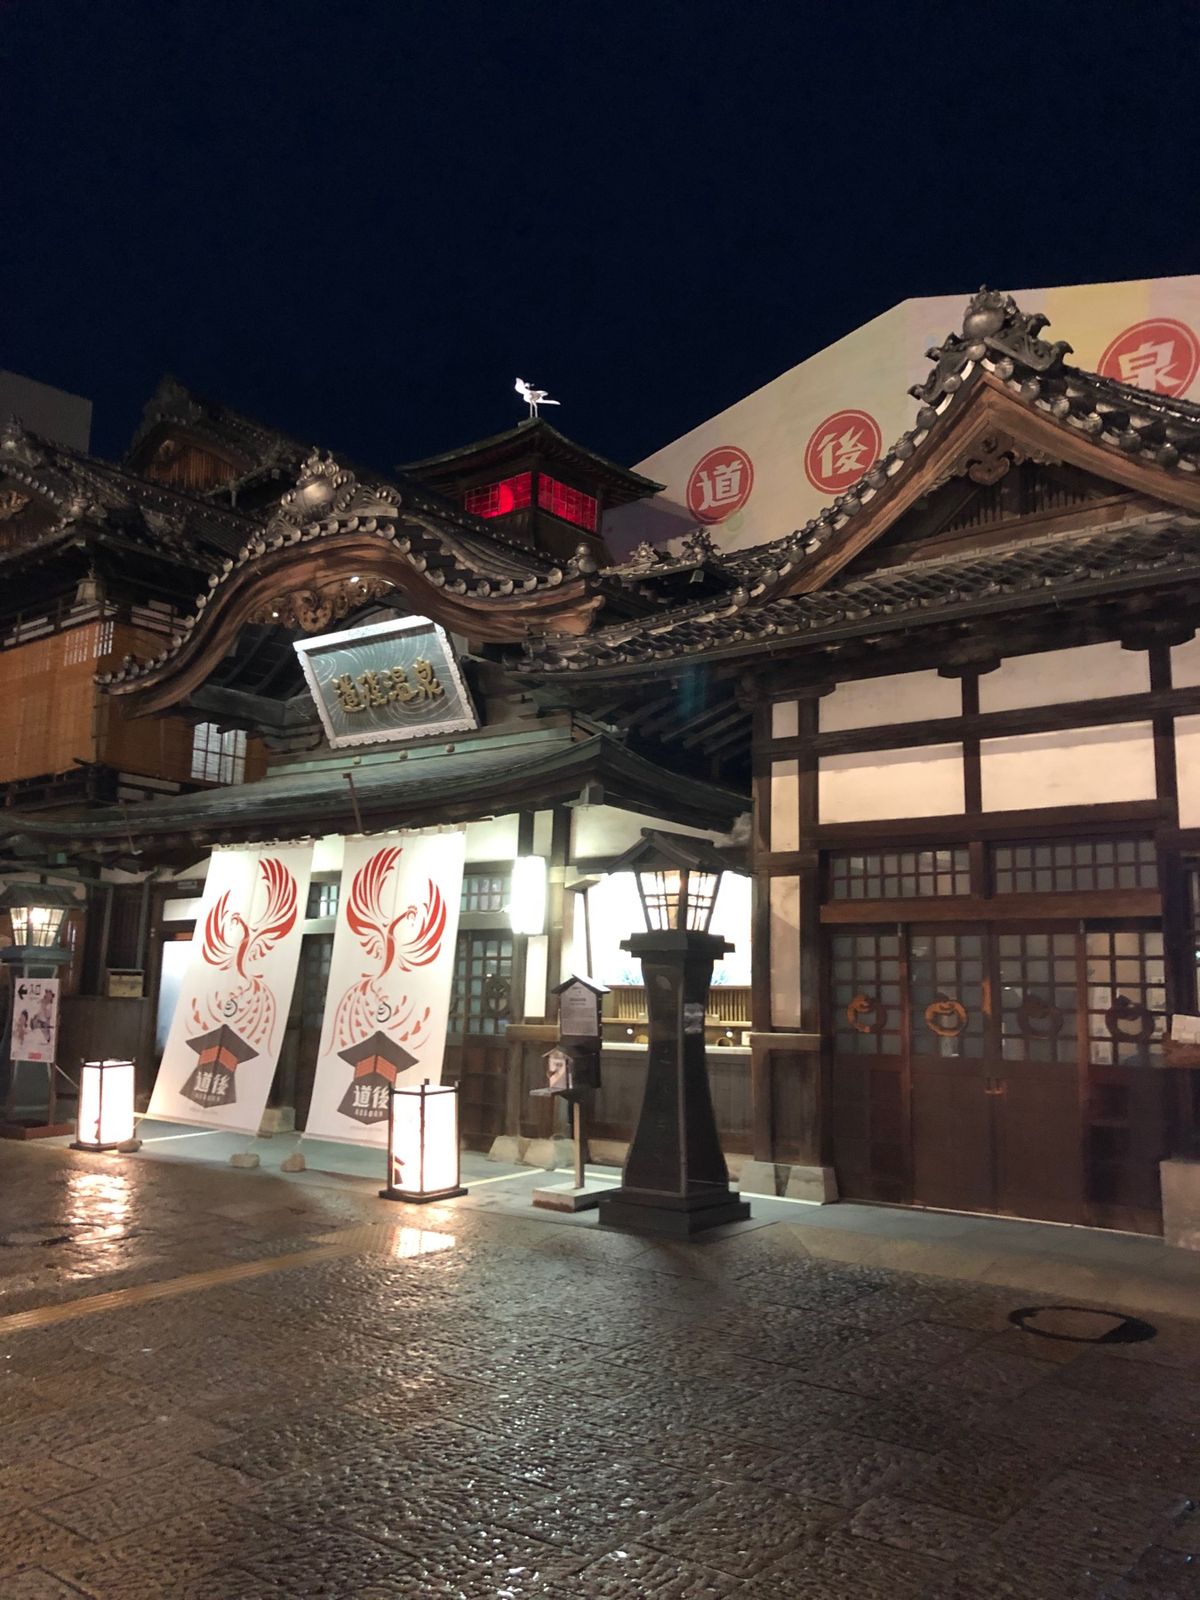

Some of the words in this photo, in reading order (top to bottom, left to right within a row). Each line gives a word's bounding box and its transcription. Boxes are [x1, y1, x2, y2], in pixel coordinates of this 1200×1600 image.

[696, 460, 743, 511] 道
[816, 426, 869, 479] 後
[1118, 340, 1184, 391] 泉
[193, 1071, 230, 1095] 道後
[352, 1085, 389, 1109] 道後
